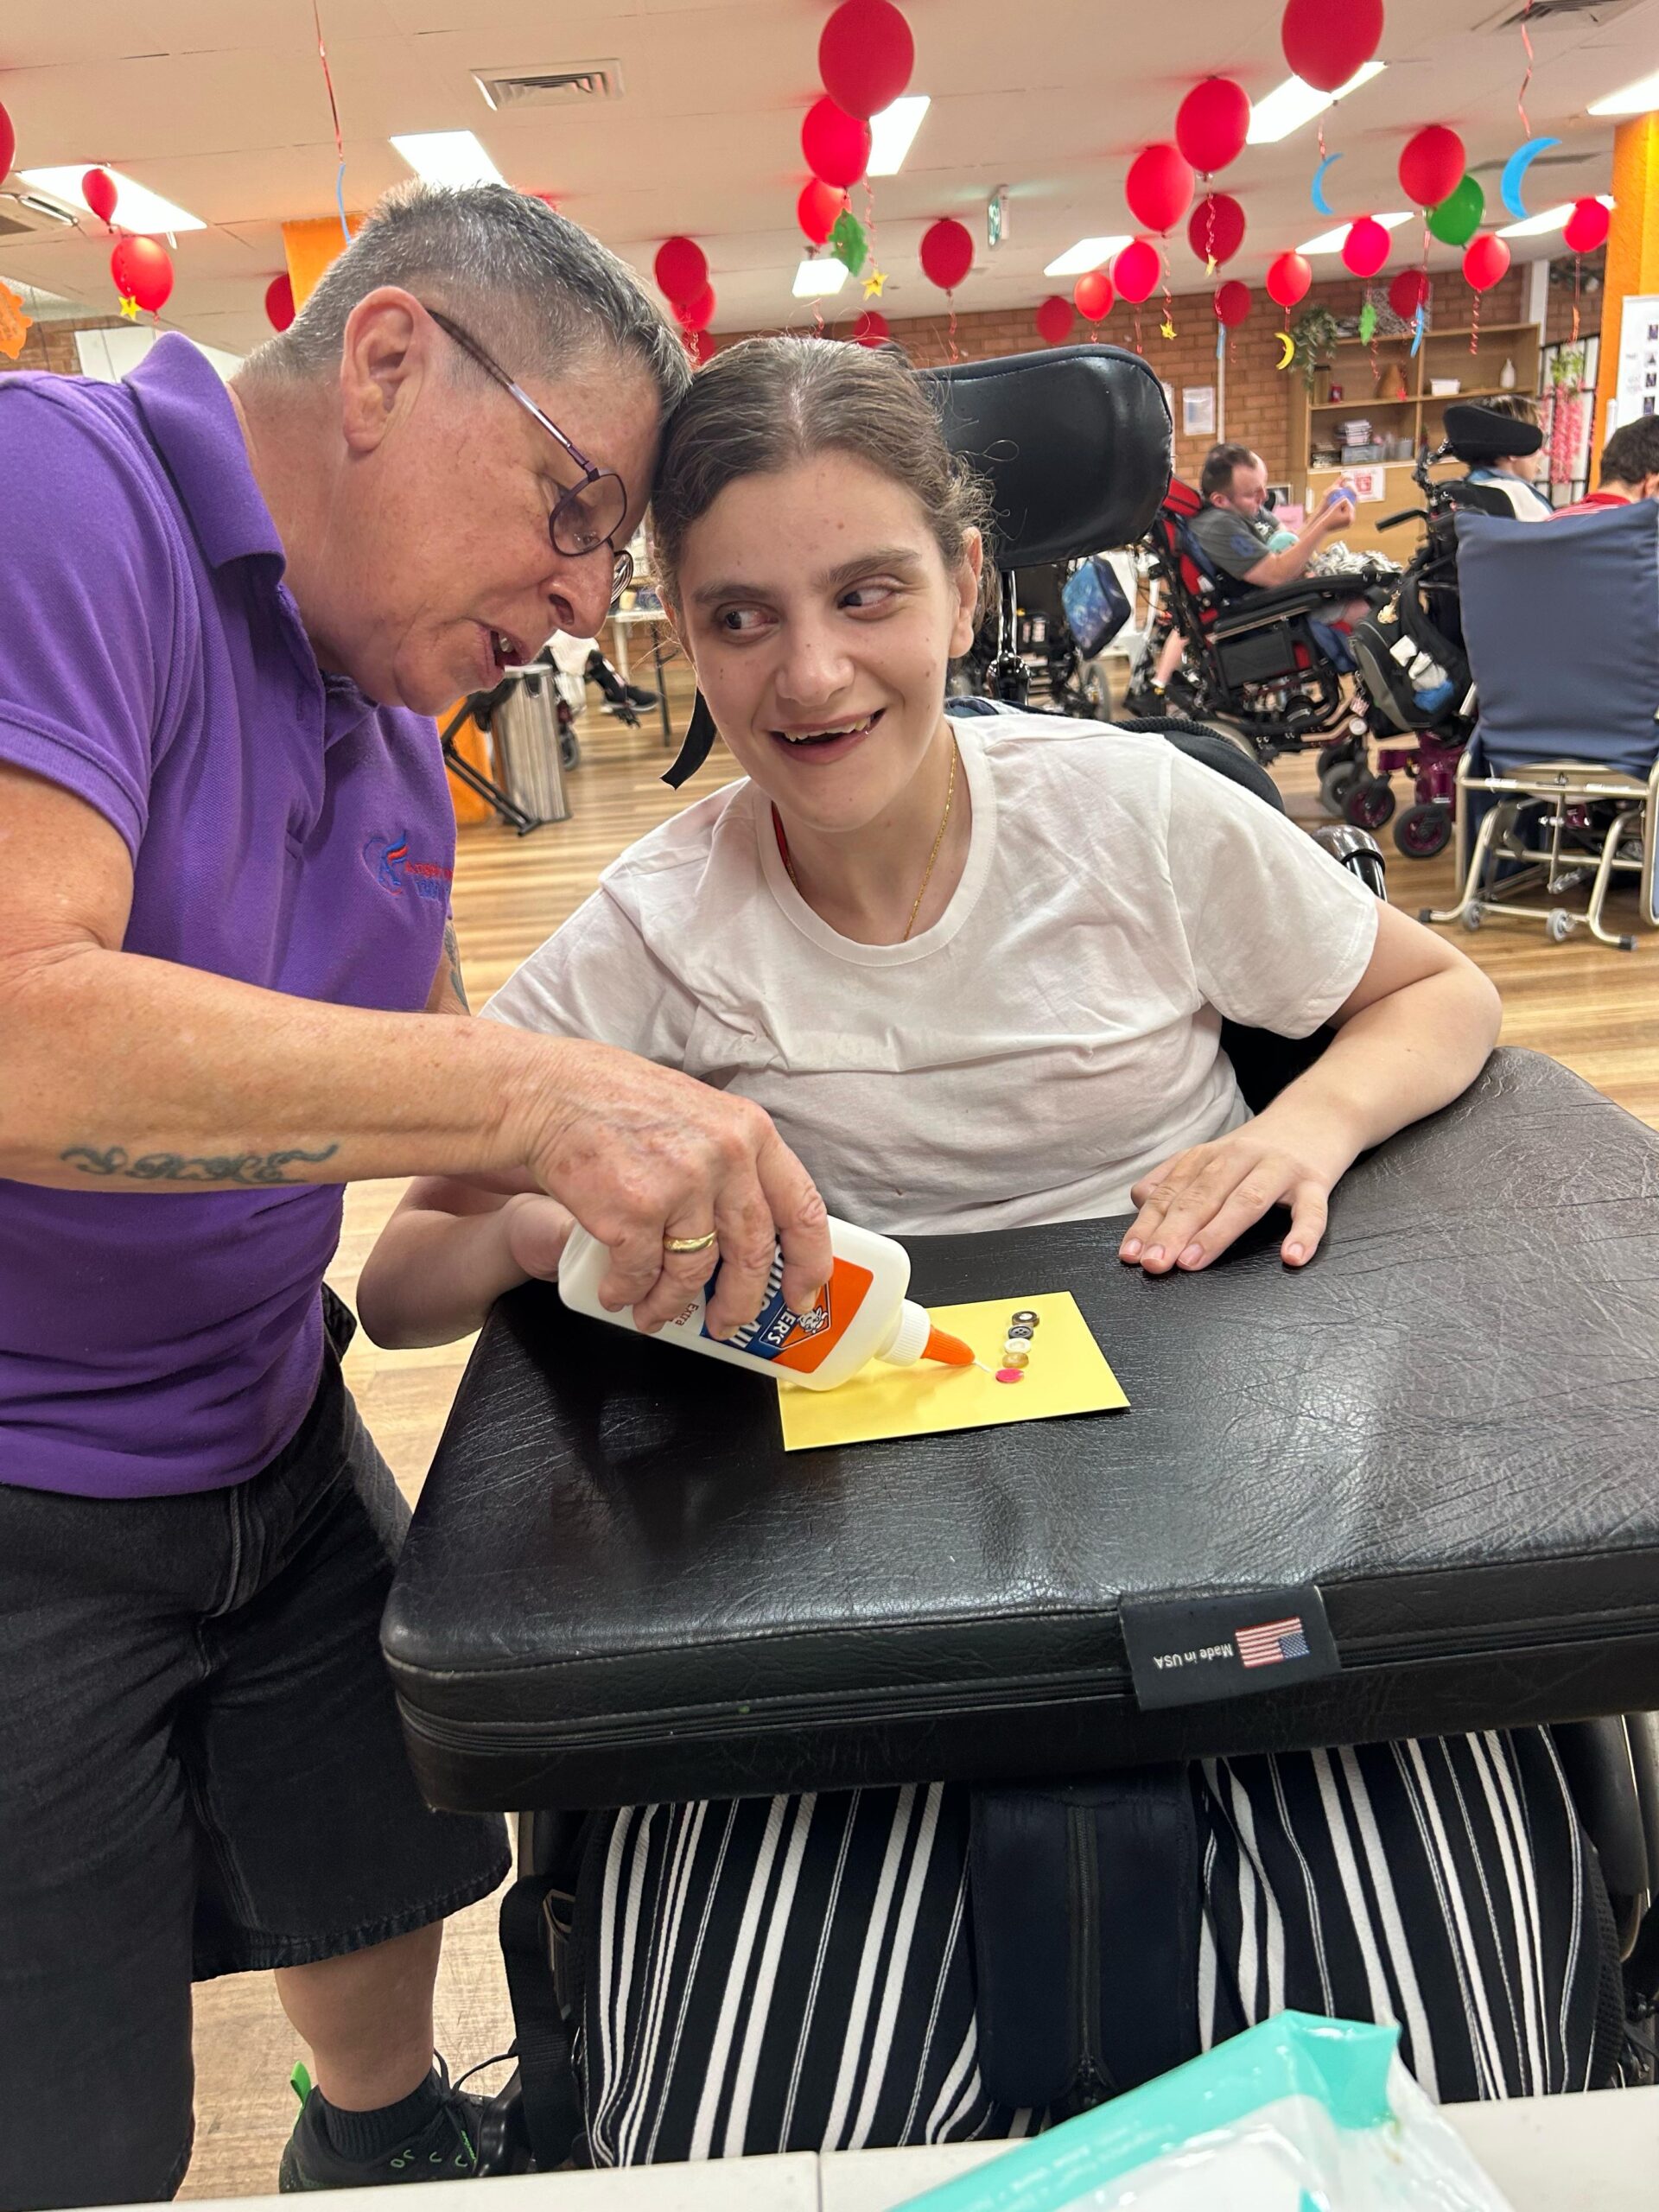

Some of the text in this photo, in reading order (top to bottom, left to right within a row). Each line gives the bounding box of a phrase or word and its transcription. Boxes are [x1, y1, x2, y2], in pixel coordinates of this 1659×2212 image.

[676, 1303, 699, 1326] Extra
[767, 1308, 797, 1344] ER'S
[1153, 1643, 1234, 1670] Made in USA
